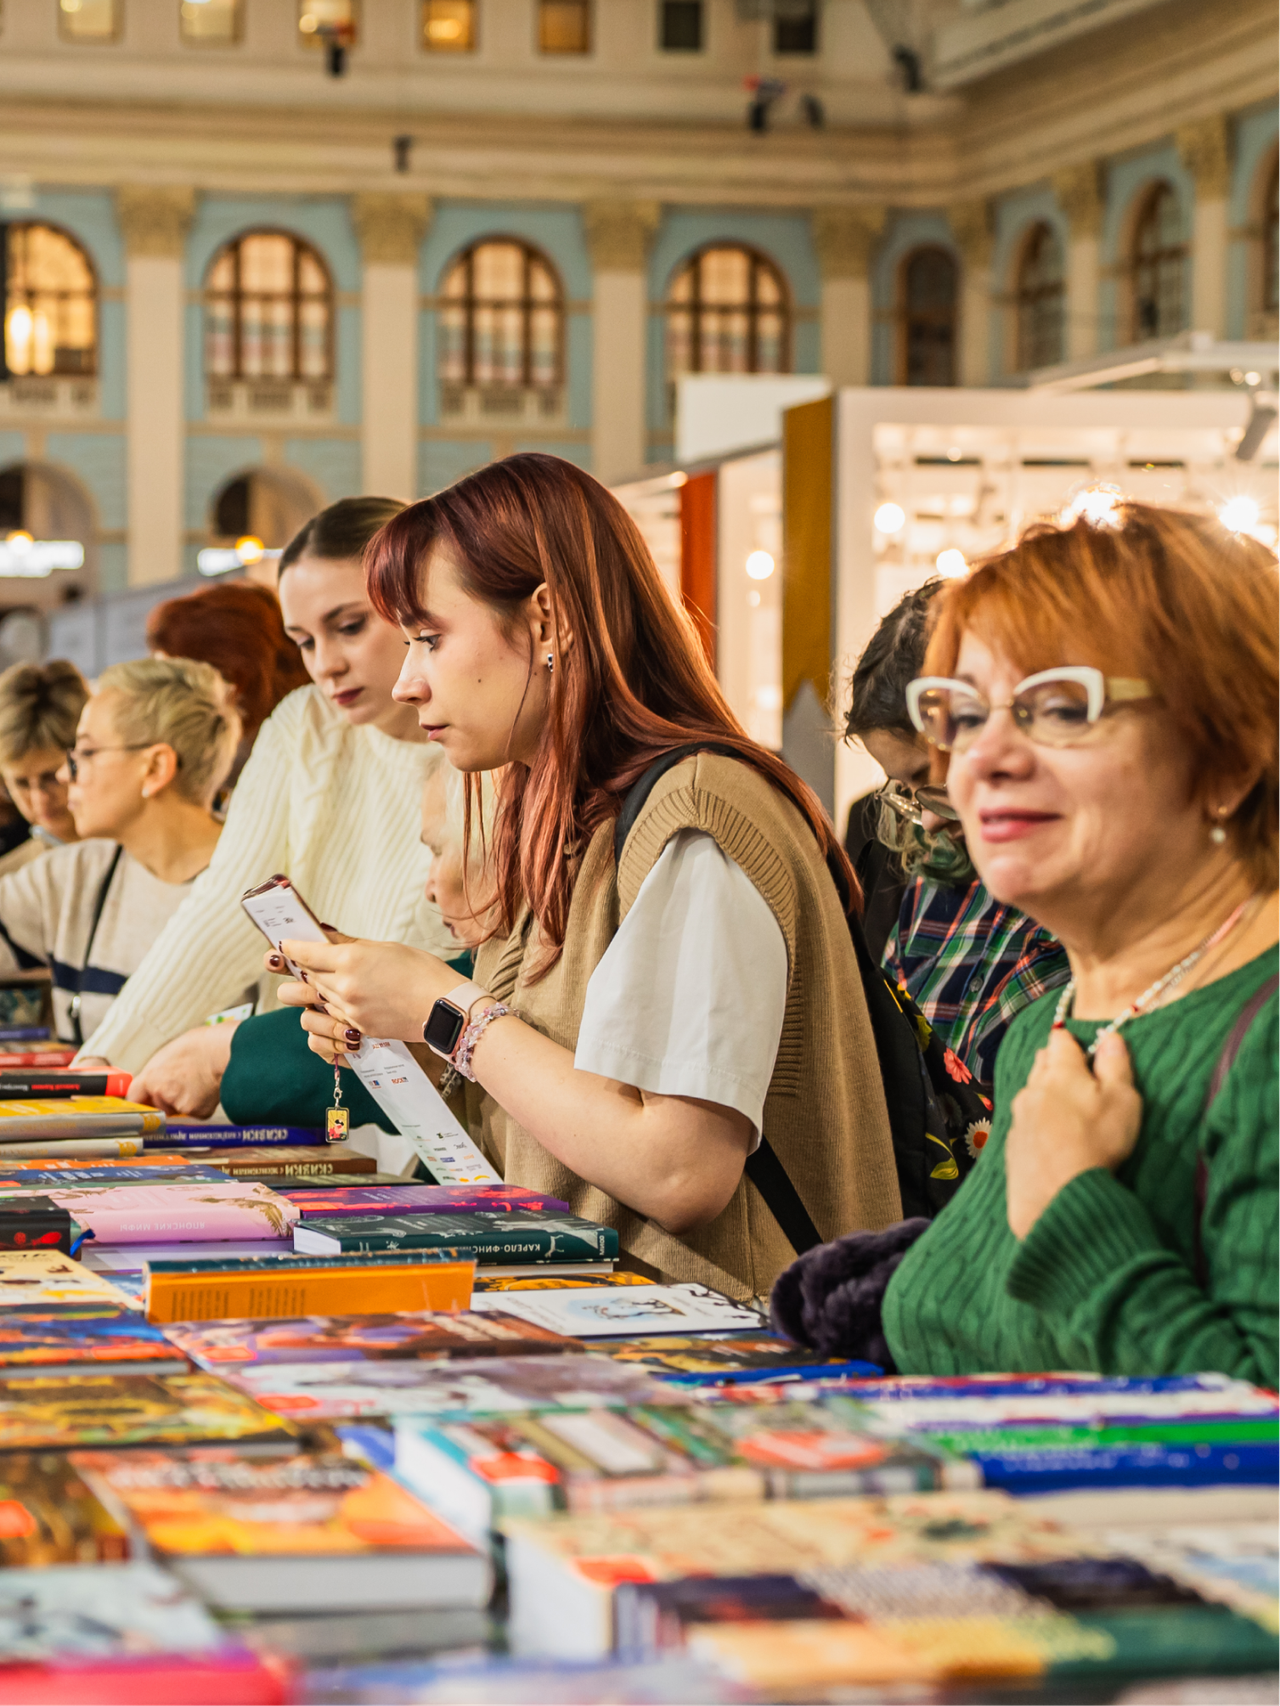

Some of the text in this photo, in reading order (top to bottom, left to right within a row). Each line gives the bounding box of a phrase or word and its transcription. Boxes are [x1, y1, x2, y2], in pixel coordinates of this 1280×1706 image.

[242, 1129, 288, 1141] СКАЗКИ
[285, 1164, 333, 1176] СКАЗКИ
[154, 1222, 205, 1231] ЯПОНСКИЕ
[464, 1243, 541, 1254] КАРЕЛО-ФИНС
